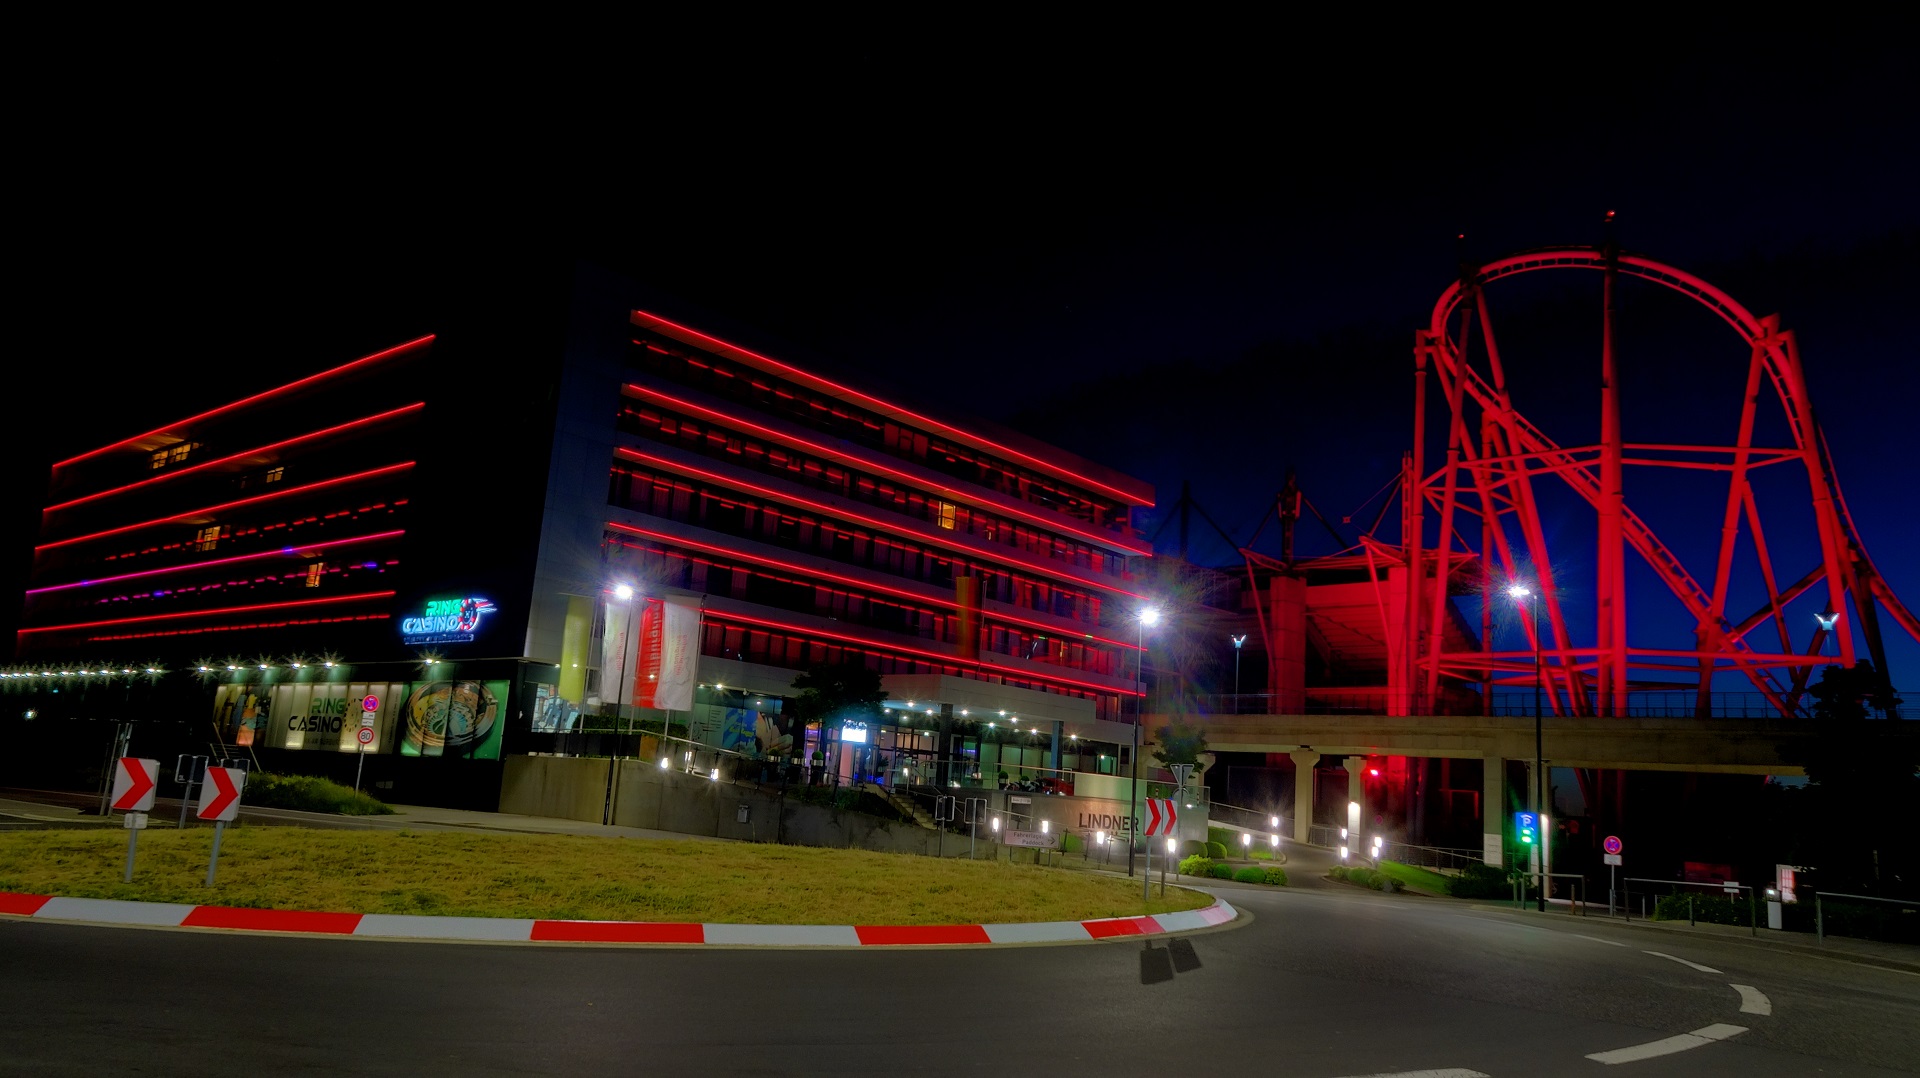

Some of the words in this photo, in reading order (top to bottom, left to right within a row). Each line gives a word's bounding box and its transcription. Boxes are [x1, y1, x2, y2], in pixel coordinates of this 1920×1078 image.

[426, 599, 461, 616] RING
[402, 615, 459, 633] CASINO
[311, 698, 346, 714] RING
[288, 715, 343, 733] CASINO
[360, 731, 371, 741] 80
[1022, 839, 1045, 847] Paddock
